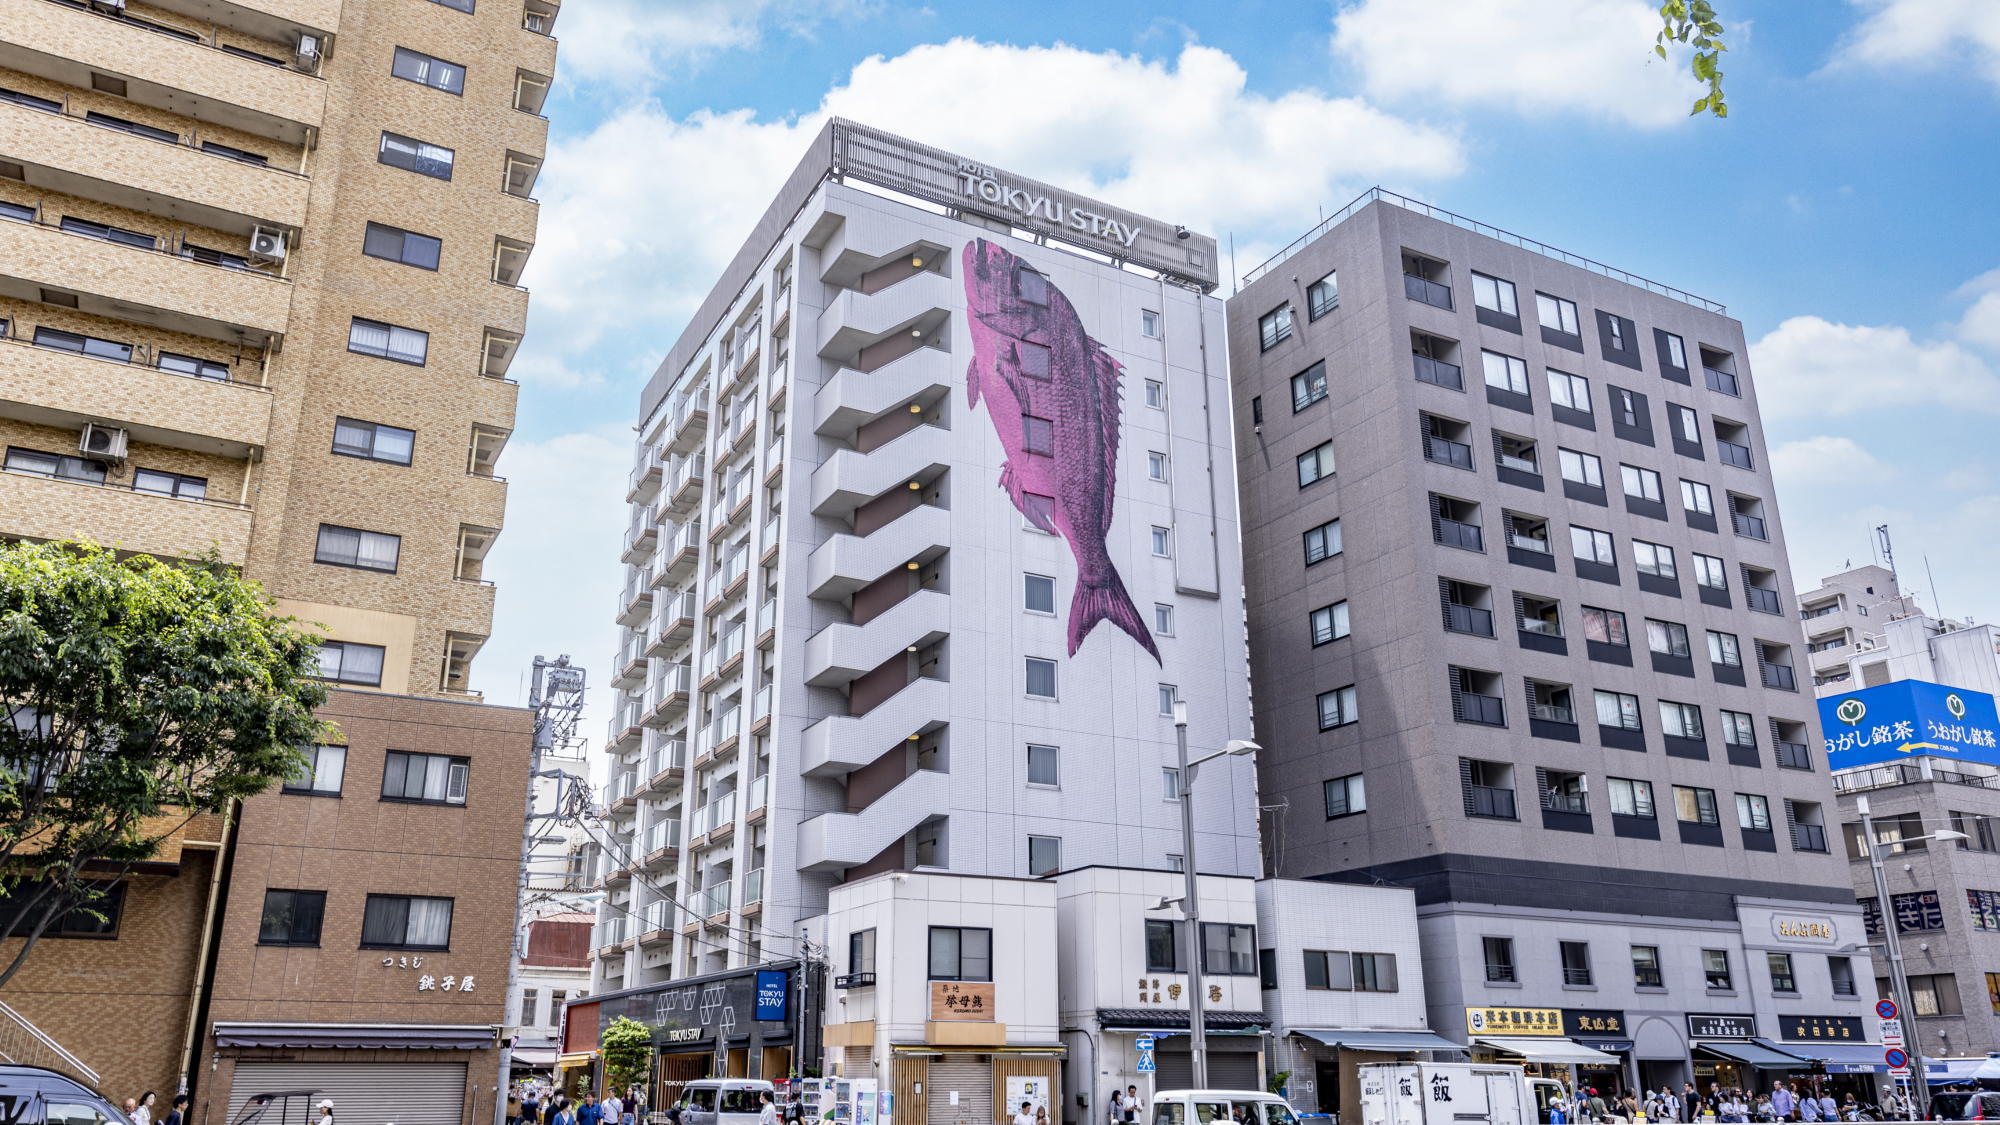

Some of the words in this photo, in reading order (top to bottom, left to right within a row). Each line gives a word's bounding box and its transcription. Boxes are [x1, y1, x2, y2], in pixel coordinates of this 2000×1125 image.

[957, 159, 997, 181] HOTEL
[959, 171, 1063, 224] TOKYU
[1069, 207, 1141, 248] STAY
[1824, 720, 1915, 753] おがし銘茶
[1928, 720, 1997, 748] うおがし銘茶
[382, 956, 423, 968] つきじ
[419, 975, 475, 992] 銚子屋
[758, 998, 783, 1008] STAY
[759, 990, 784, 1000] TOKYU
[1486, 1010, 1558, 1025] 米本珈琲本店
[670, 1029, 687, 1042] TOKYU
[687, 1028, 702, 1040] STAY
[1399, 1077, 1413, 1096] 飯
[1430, 1073, 1452, 1102] 飯
